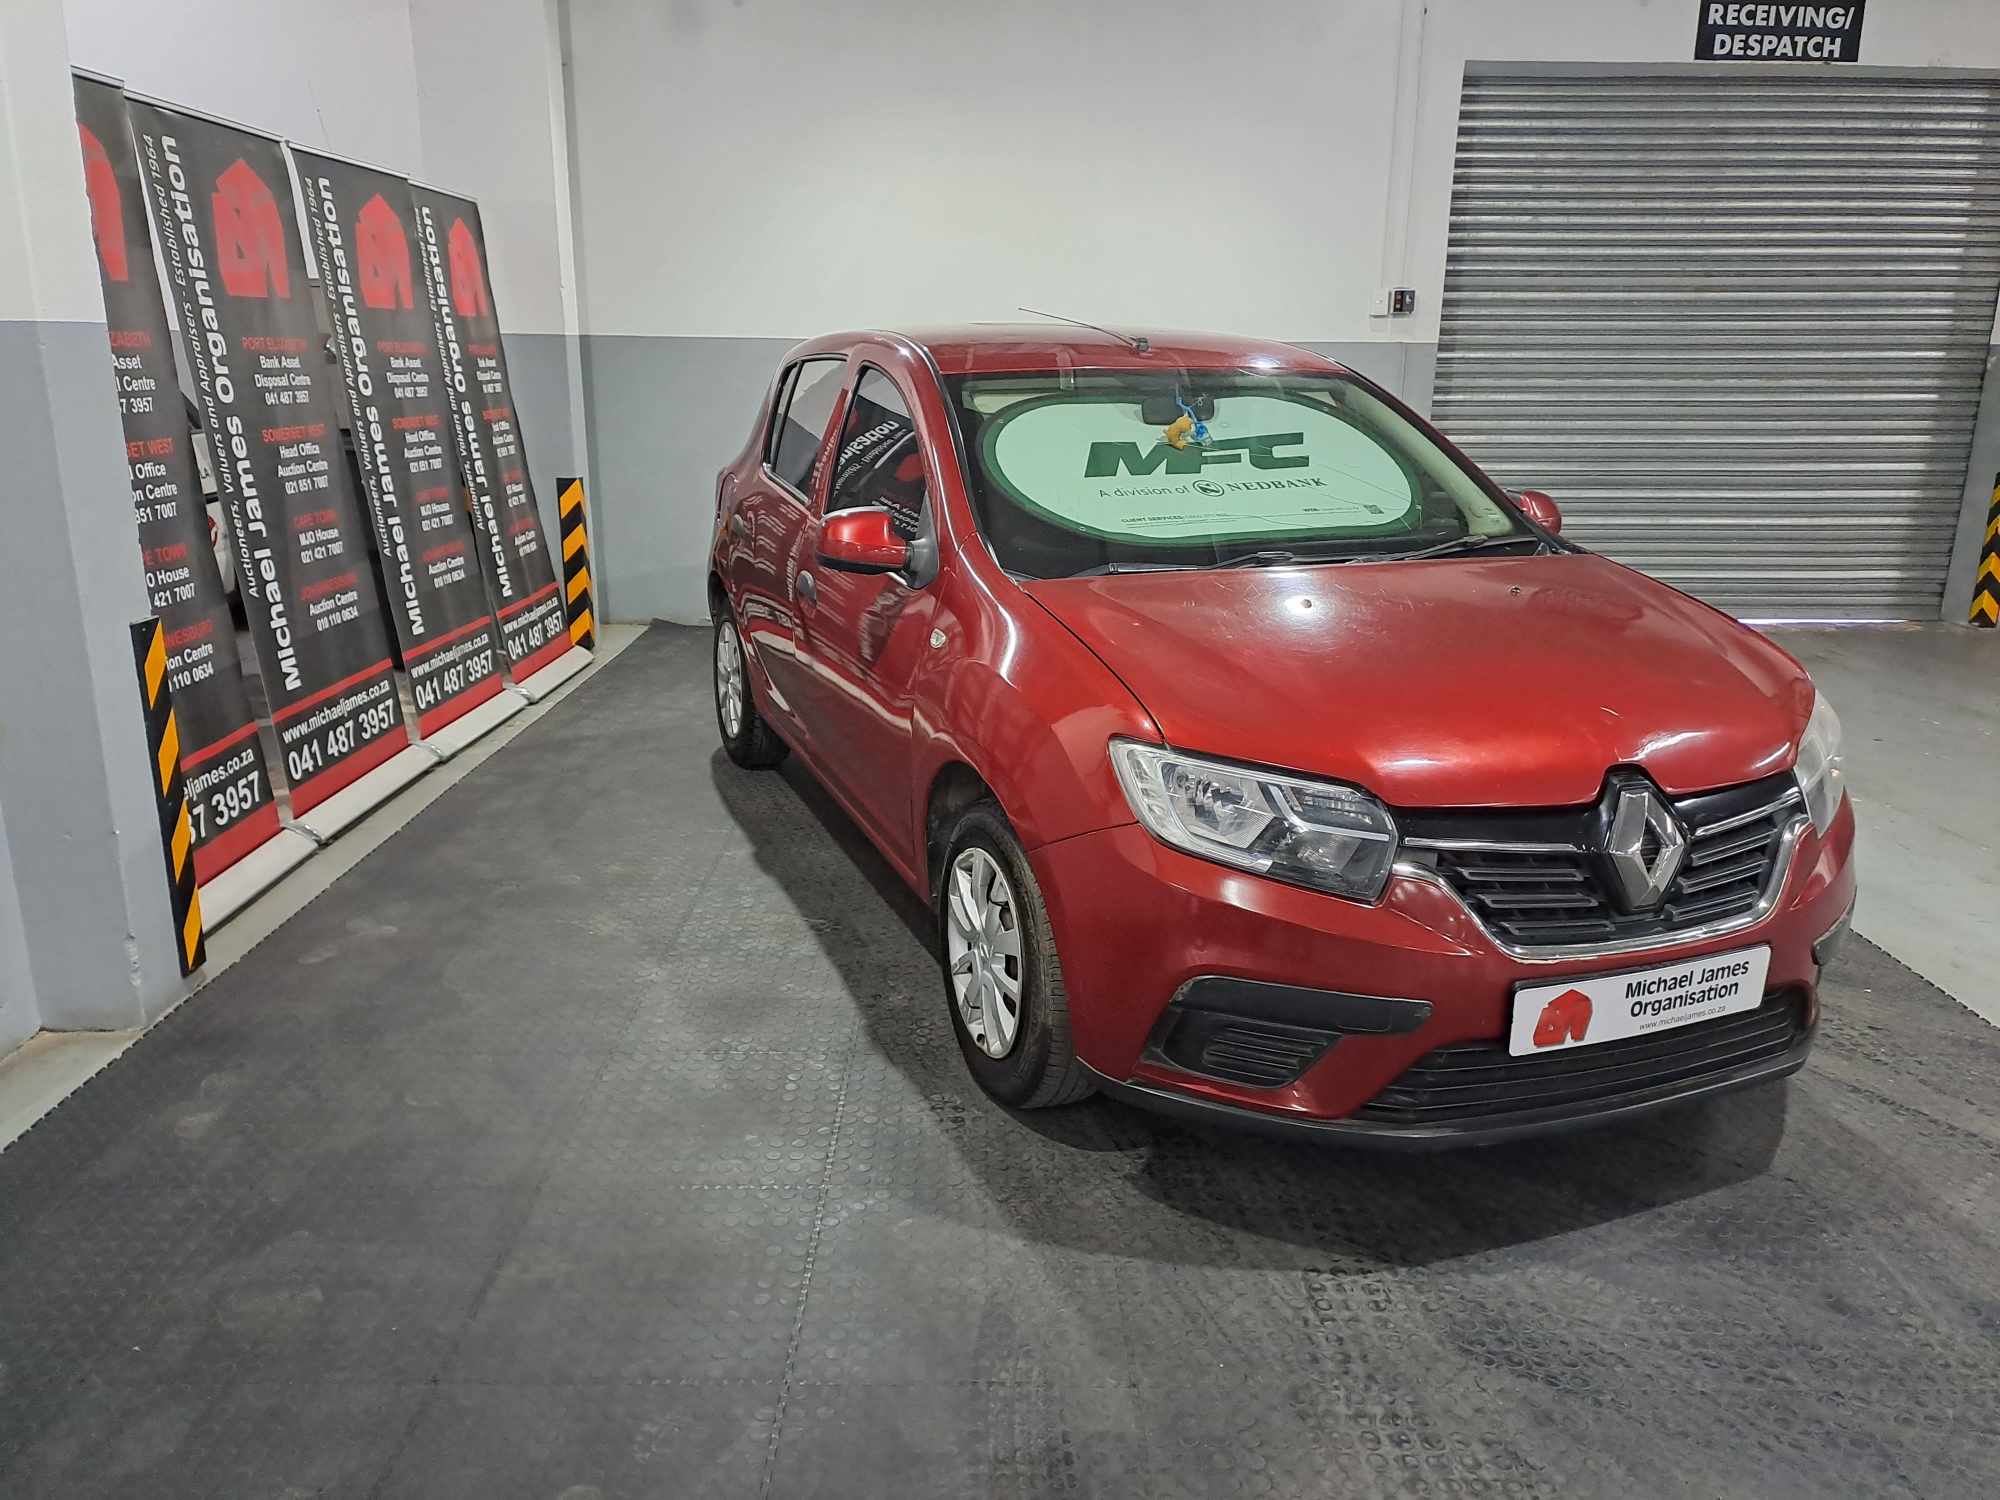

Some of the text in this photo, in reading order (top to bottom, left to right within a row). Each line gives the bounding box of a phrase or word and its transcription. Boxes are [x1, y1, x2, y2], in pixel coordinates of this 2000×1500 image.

[1707, 3, 1856, 30] RECEIVING/
[1713, 34, 1842, 58] DESPATCH
[142, 134, 161, 179] 1964
[154, 183, 187, 286] Established
[311, 215, 338, 301] Established
[421, 206, 466, 393] Organisation
[112, 355, 142, 370] Asset
[181, 302, 213, 392] Appraisers
[259, 355, 279, 368] Bank
[333, 313, 355, 387] Appraisers
[124, 376, 156, 392] Centre
[254, 373, 290, 388] Disposal
[131, 397, 153, 414] 3957
[161, 135, 302, 691] Michael James Organisation
[201, 395, 219, 428] and
[318, 177, 425, 636] Michael James Organisation
[348, 389, 361, 417] and
[446, 387, 458, 411] and
[147, 438, 174, 456] WEST
[356, 420, 372, 470] Valuers
[453, 413, 467, 456] Valuers
[461, 401, 488, 489] James
[136, 463, 167, 479] Office
[218, 433, 233, 494] Valuers
[277, 463, 305, 478] Auction
[1084, 432, 1310, 478] MFC
[146, 481, 178, 500] Centre
[1098, 476, 1328, 499] A division of NEDBANK
[156, 502, 177, 519] 7007
[369, 475, 392, 557] Auctioneers,
[231, 500, 260, 599] Auctioneers,
[316, 526, 339, 541] House
[480, 495, 513, 597] Michael
[157, 566, 190, 585] House
[153, 583, 196, 608] 421 7007
[309, 599, 337, 617] Auction
[329, 611, 342, 627] 110
[183, 642, 214, 664] Centre
[507, 614, 564, 661] 041 487 3957
[173, 671, 191, 689] 110
[192, 662, 214, 682] 0634
[416, 649, 493, 709] 041 487 3957
[282, 679, 390, 745] www.michaeljames.co.za
[288, 700, 396, 781] 041 487 3957
[211, 770, 261, 826] 3957
[1625, 960, 1750, 1000] Michael James
[1630, 980, 1739, 1018] Organisation
